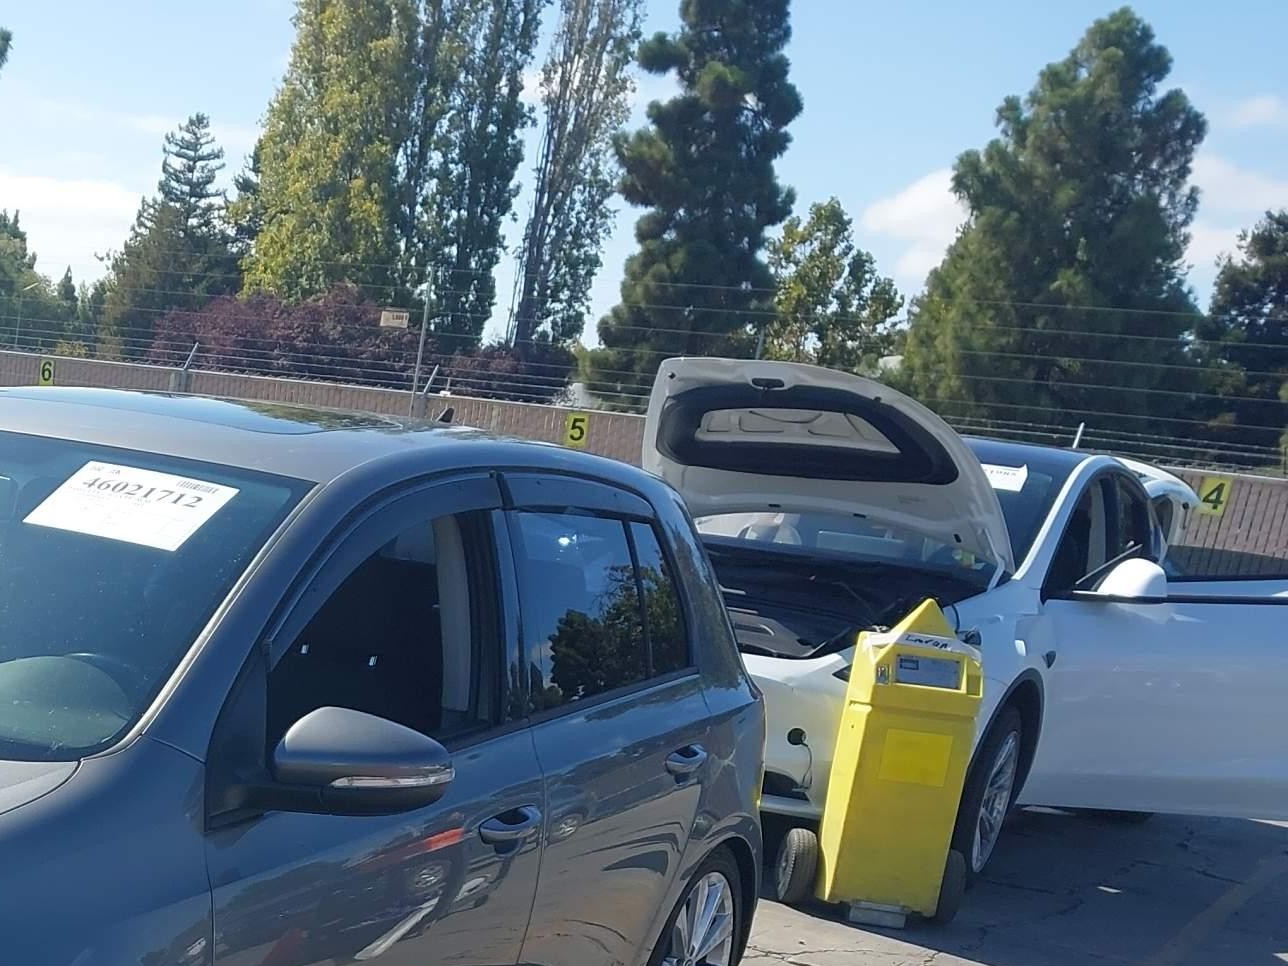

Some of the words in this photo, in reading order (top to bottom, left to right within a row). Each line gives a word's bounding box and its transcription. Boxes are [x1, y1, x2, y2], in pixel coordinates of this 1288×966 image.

[42, 361, 52, 381] 6
[570, 417, 585, 441] 5
[82, 476, 204, 508] 46021712
[1202, 482, 1225, 509] 4
